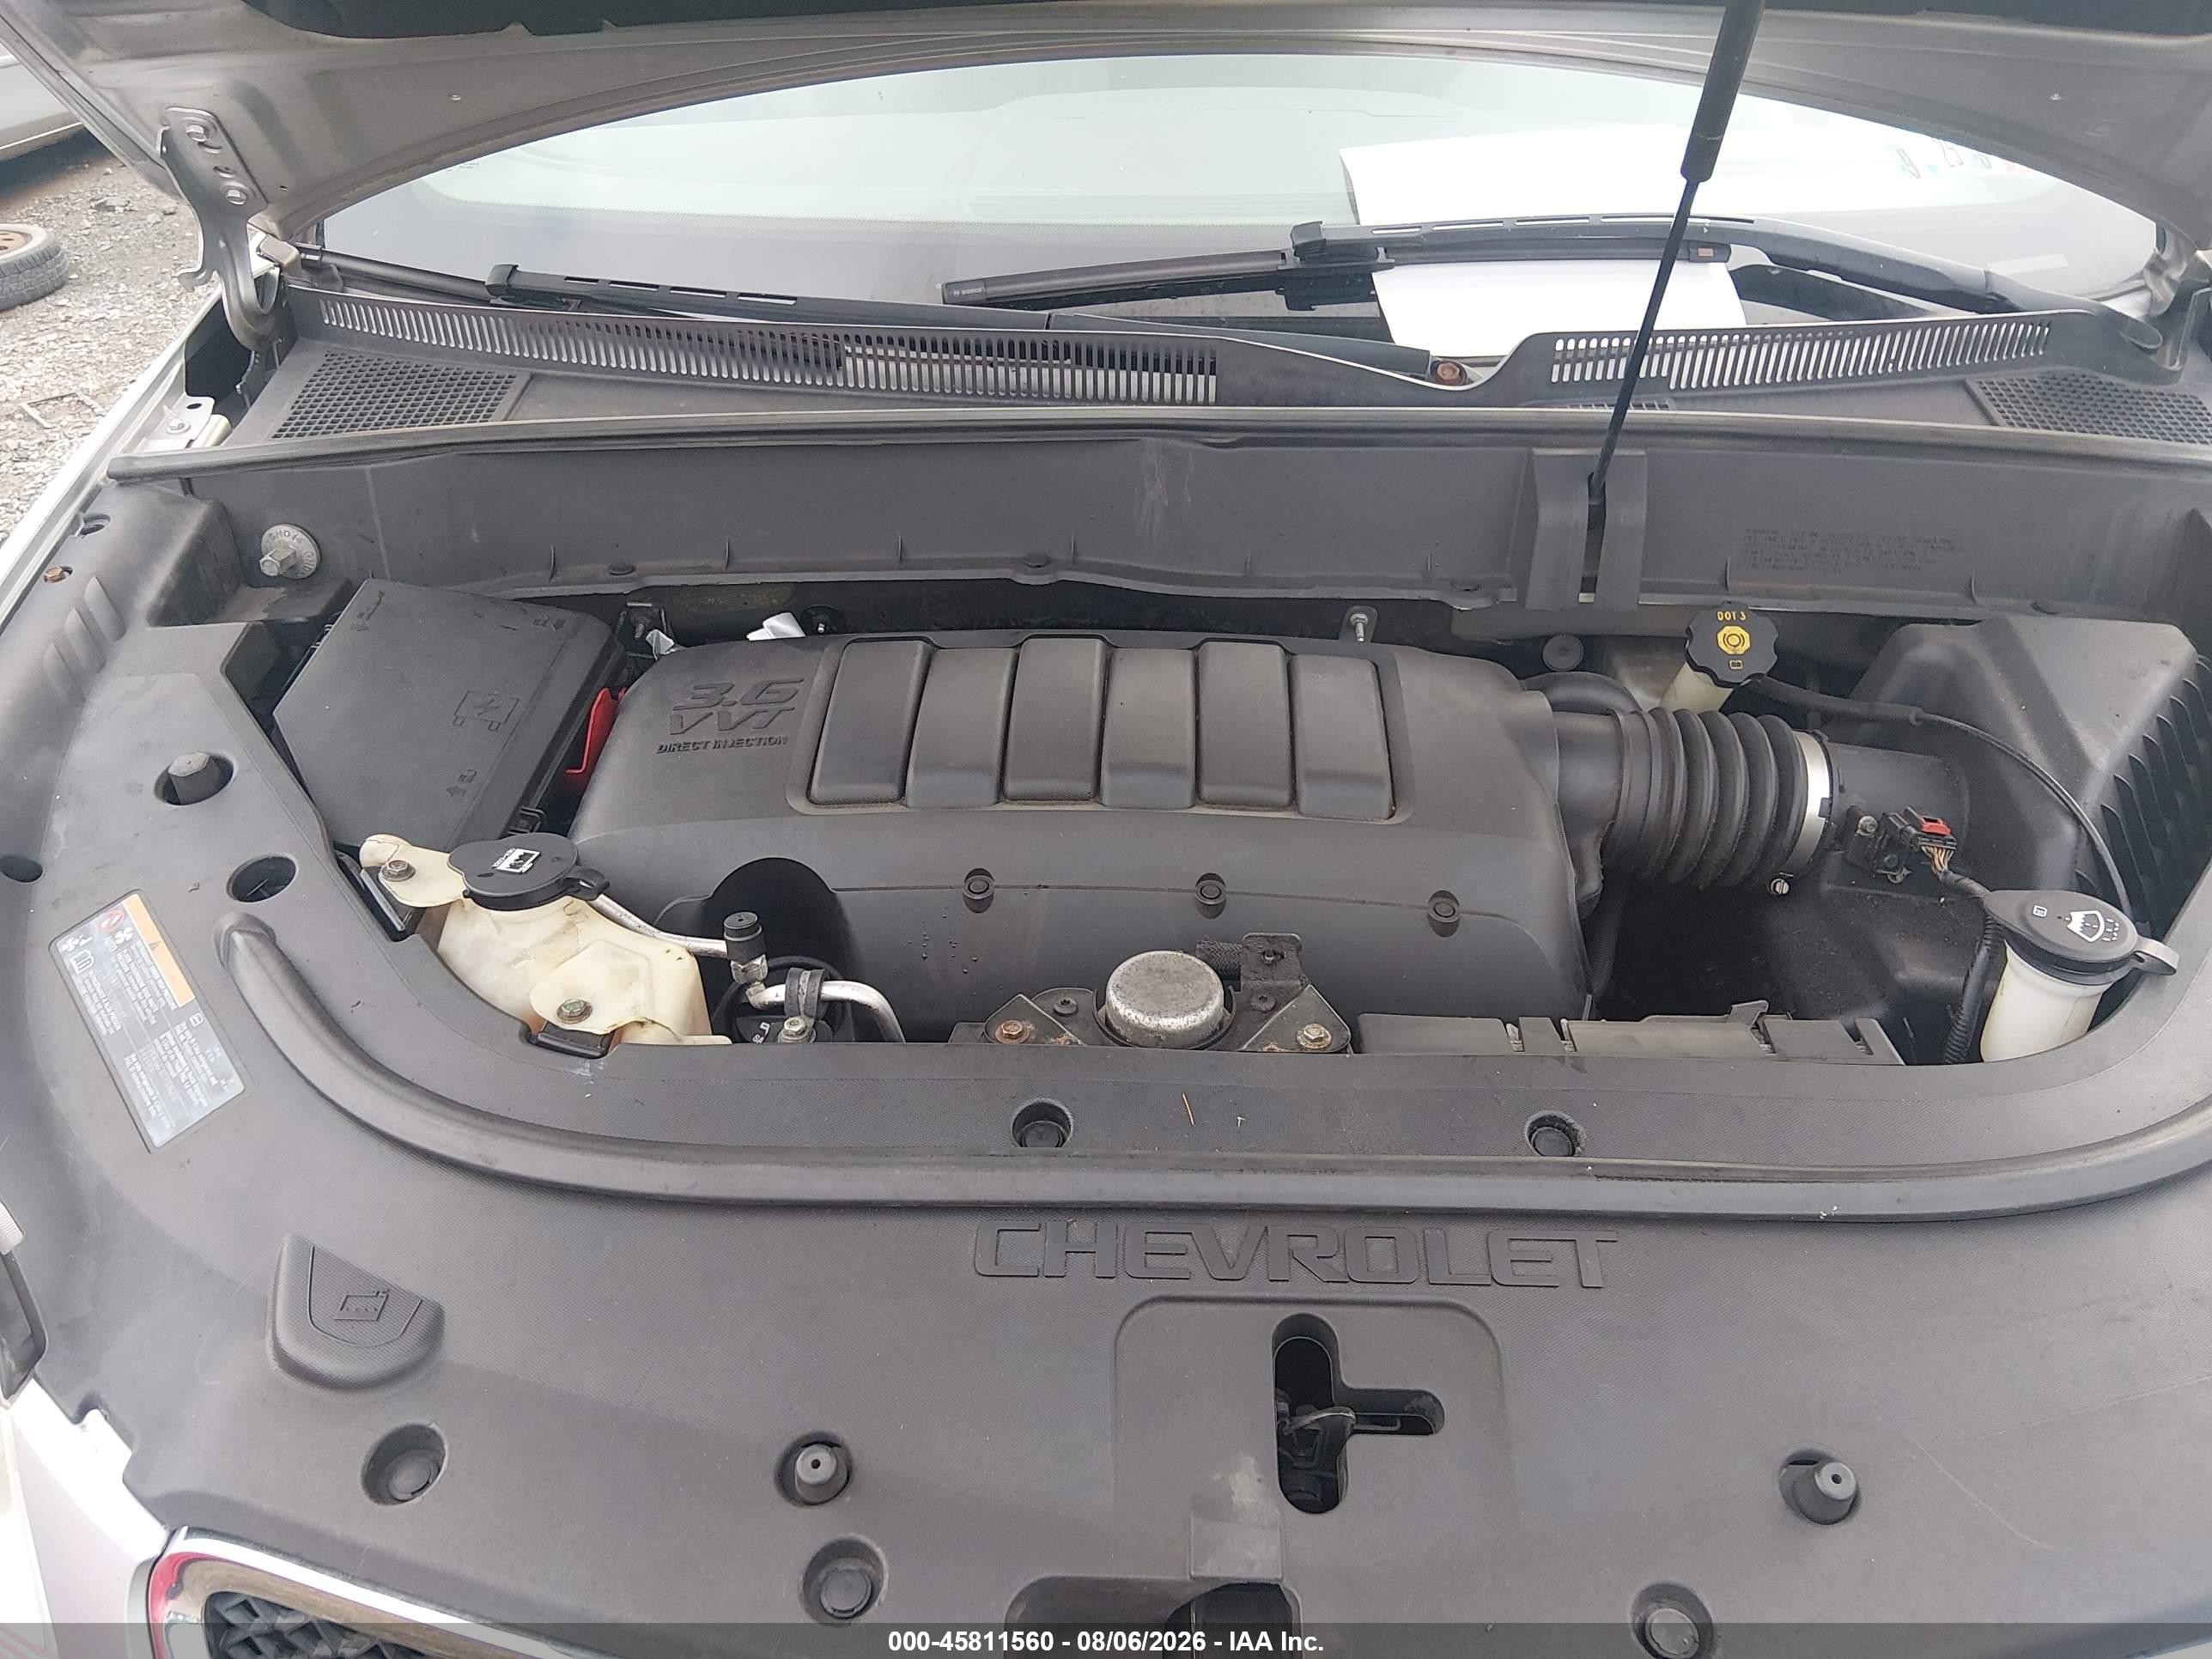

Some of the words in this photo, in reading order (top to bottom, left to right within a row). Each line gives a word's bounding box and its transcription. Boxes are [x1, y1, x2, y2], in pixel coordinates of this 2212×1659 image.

[672, 678, 805, 711] 3.6
[669, 707, 796, 736] VVT
[657, 740, 711, 754] DIRECT
[712, 735, 789, 750] INJECTION
[975, 1219, 1619, 1289] CHEVROLET
